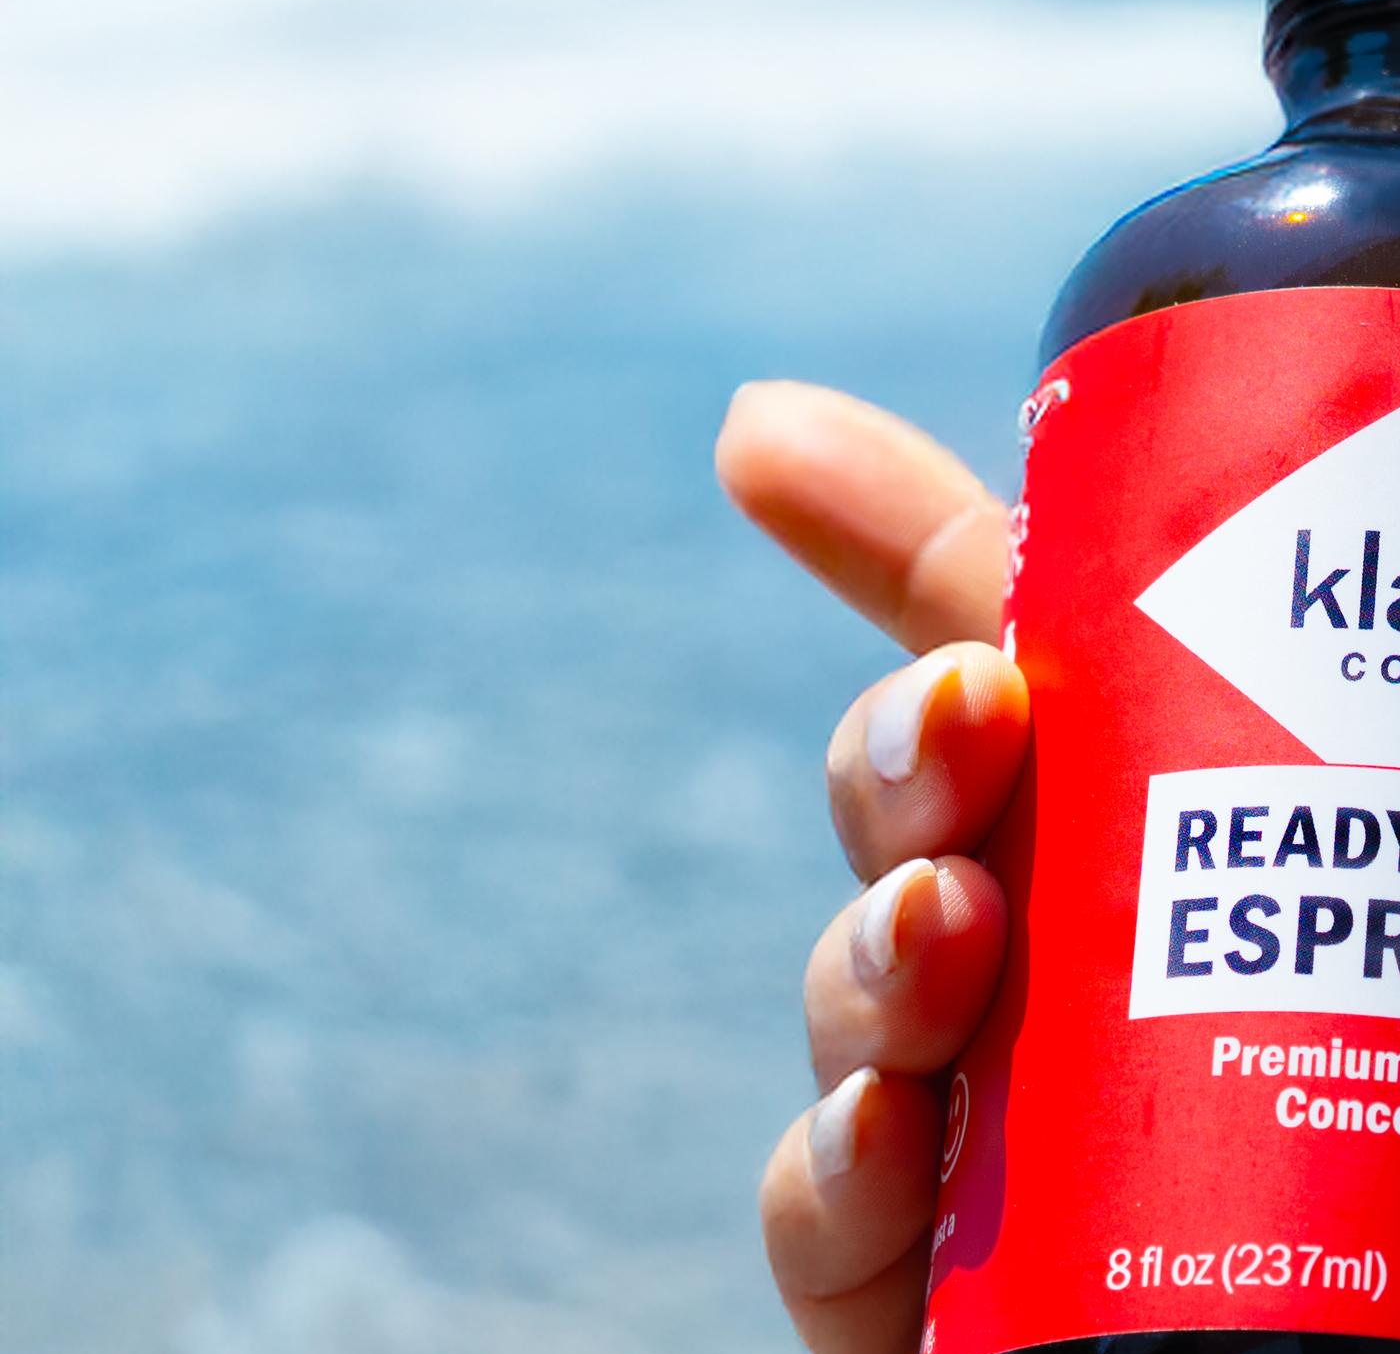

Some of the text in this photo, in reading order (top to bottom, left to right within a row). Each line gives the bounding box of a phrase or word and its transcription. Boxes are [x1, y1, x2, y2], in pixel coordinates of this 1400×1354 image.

[1106, 1243, 1389, 1301] 8 fl oz (237ml)
